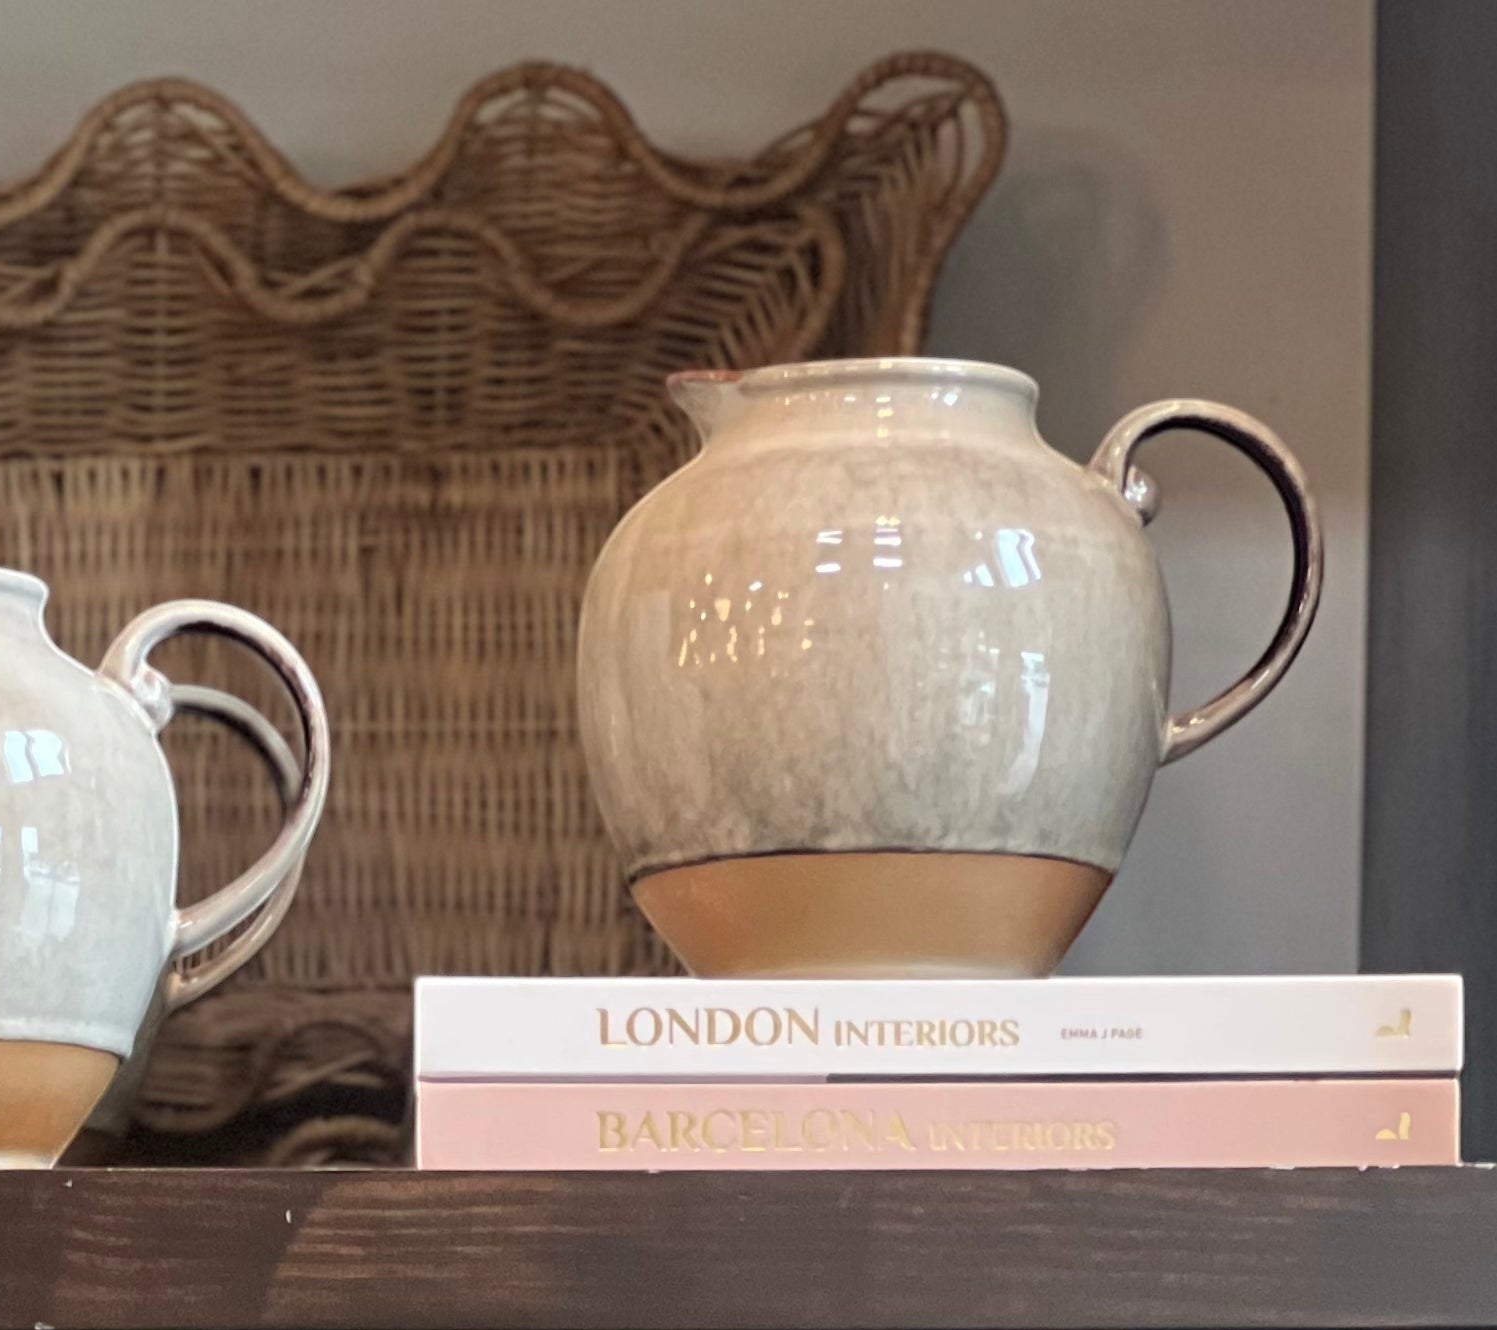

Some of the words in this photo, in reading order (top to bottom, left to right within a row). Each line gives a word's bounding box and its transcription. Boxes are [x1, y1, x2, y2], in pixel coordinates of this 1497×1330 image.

[595, 1007, 819, 1047] LONDON
[834, 1019, 1020, 1047] INTERIORS
[1060, 1027, 1097, 1041] EMMA
[1111, 1027, 1143, 1041] PAGE
[595, 1107, 917, 1152] BARCELONA
[928, 1118, 1118, 1152] INTERIORS
